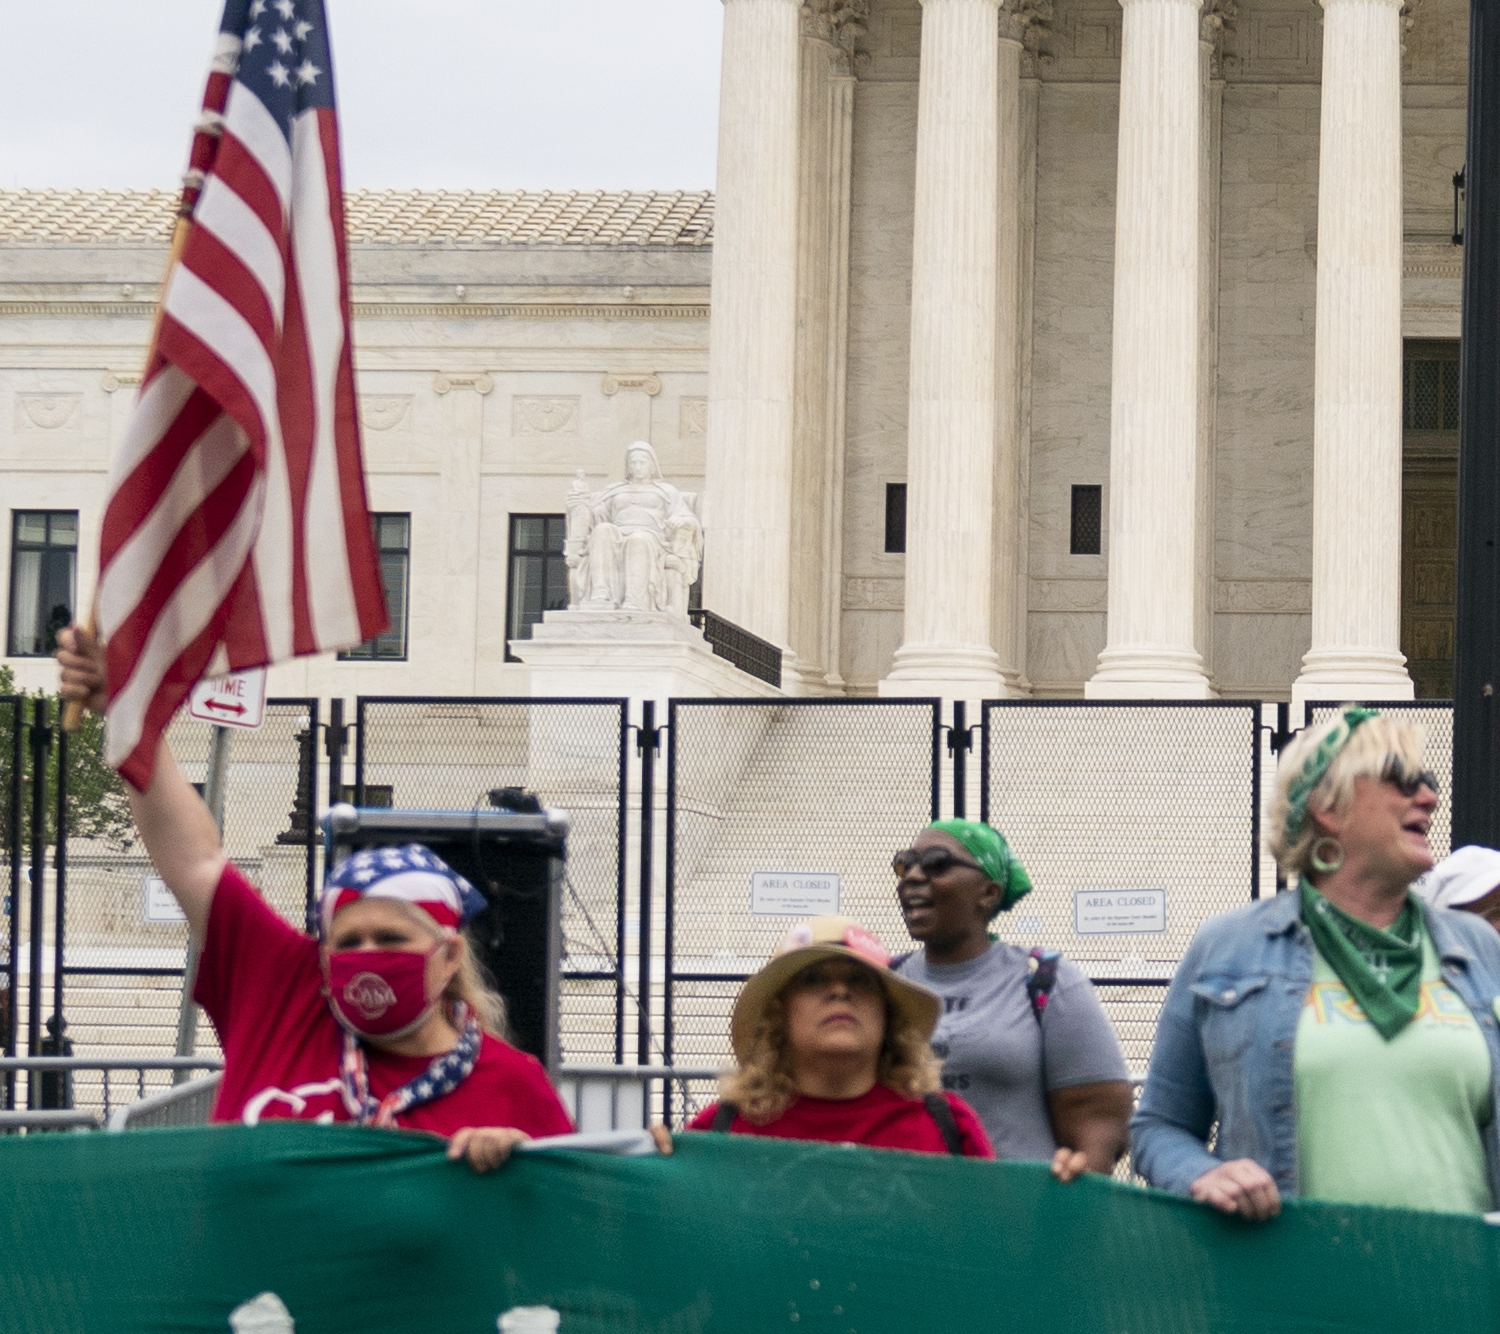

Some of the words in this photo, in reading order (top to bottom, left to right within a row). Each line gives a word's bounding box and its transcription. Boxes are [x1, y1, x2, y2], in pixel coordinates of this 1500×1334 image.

[212, 678, 247, 698] TIME
[762, 880, 789, 890] AREA
[792, 880, 831, 891] CLOSED
[1085, 898, 1114, 907] AREA
[1117, 897, 1156, 907] CLOSED
